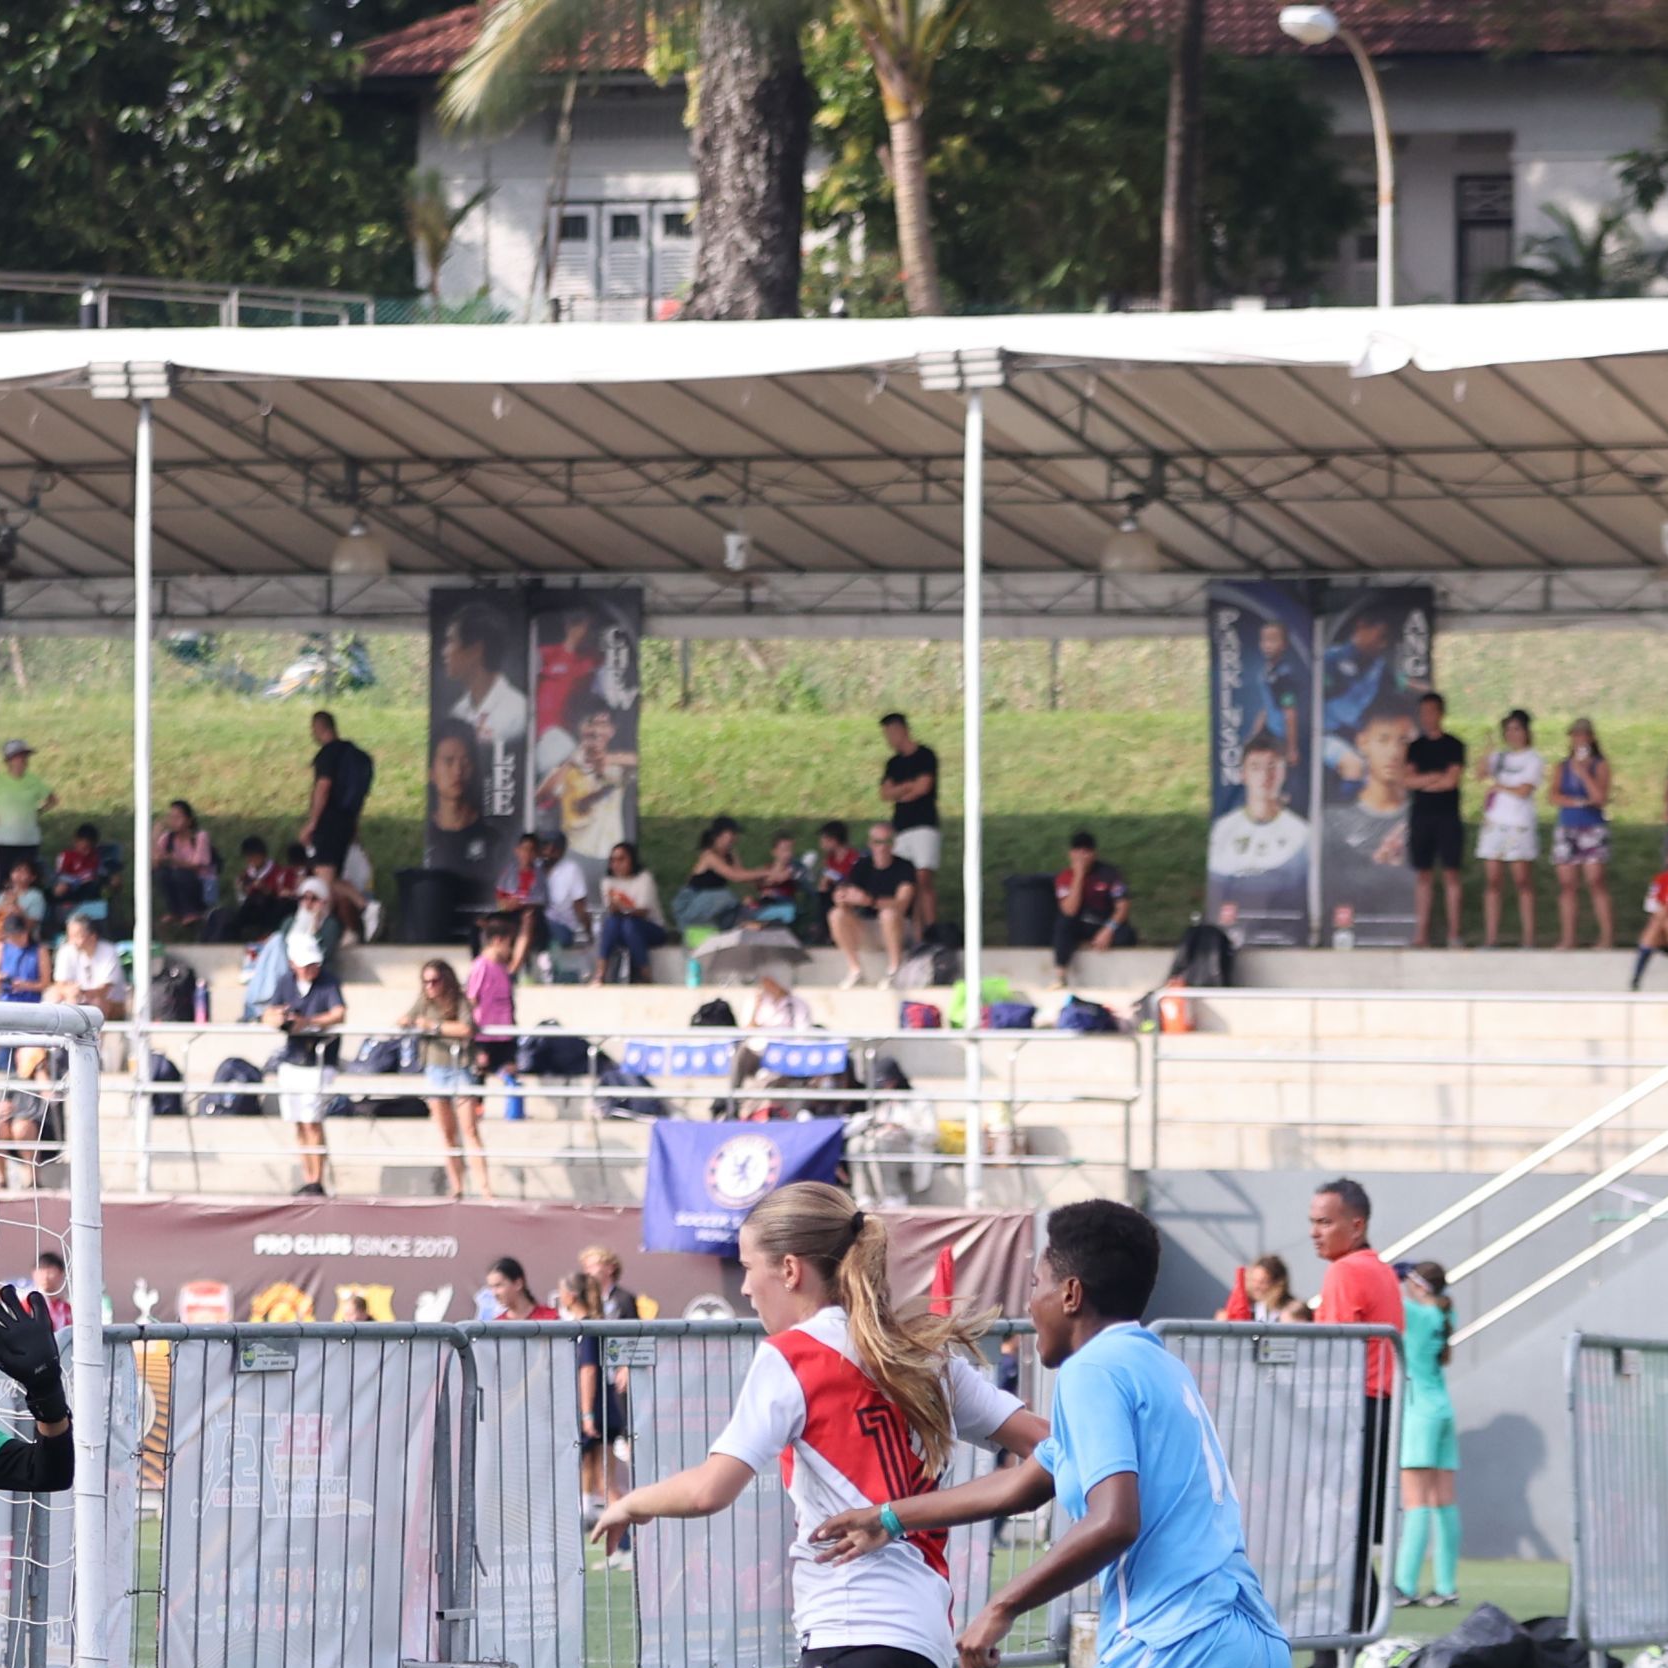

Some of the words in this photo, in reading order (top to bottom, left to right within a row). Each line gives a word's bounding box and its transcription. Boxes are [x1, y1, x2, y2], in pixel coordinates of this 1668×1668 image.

[253, 1234, 293, 1256] PRO
[294, 1234, 352, 1256] CLUBS
[354, 1235, 412, 1257] (SINCE
[413, 1236, 458, 1259] 2017)
